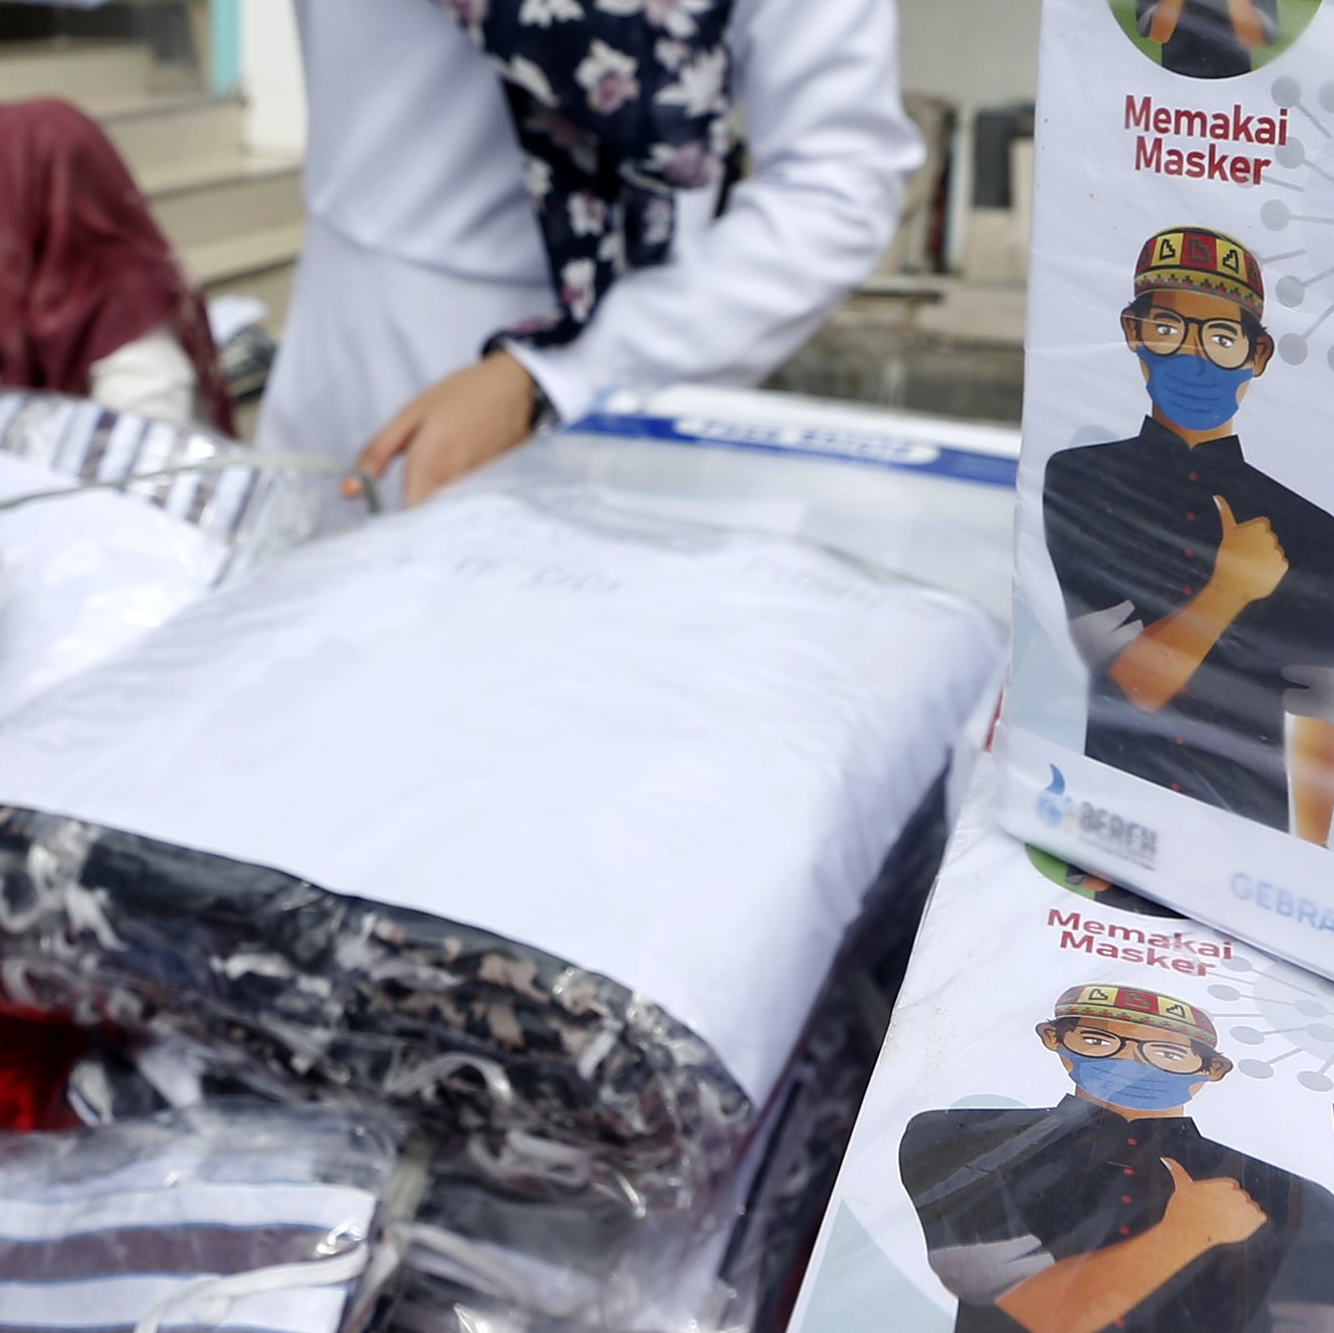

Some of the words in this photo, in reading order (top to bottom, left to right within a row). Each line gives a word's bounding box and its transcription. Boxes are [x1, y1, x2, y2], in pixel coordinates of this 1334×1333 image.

[1123, 94, 1290, 147] Memakai
[1134, 136, 1272, 186] Masker
[1047, 909, 1234, 961] Memakai
[1060, 930, 1216, 978] Masker
